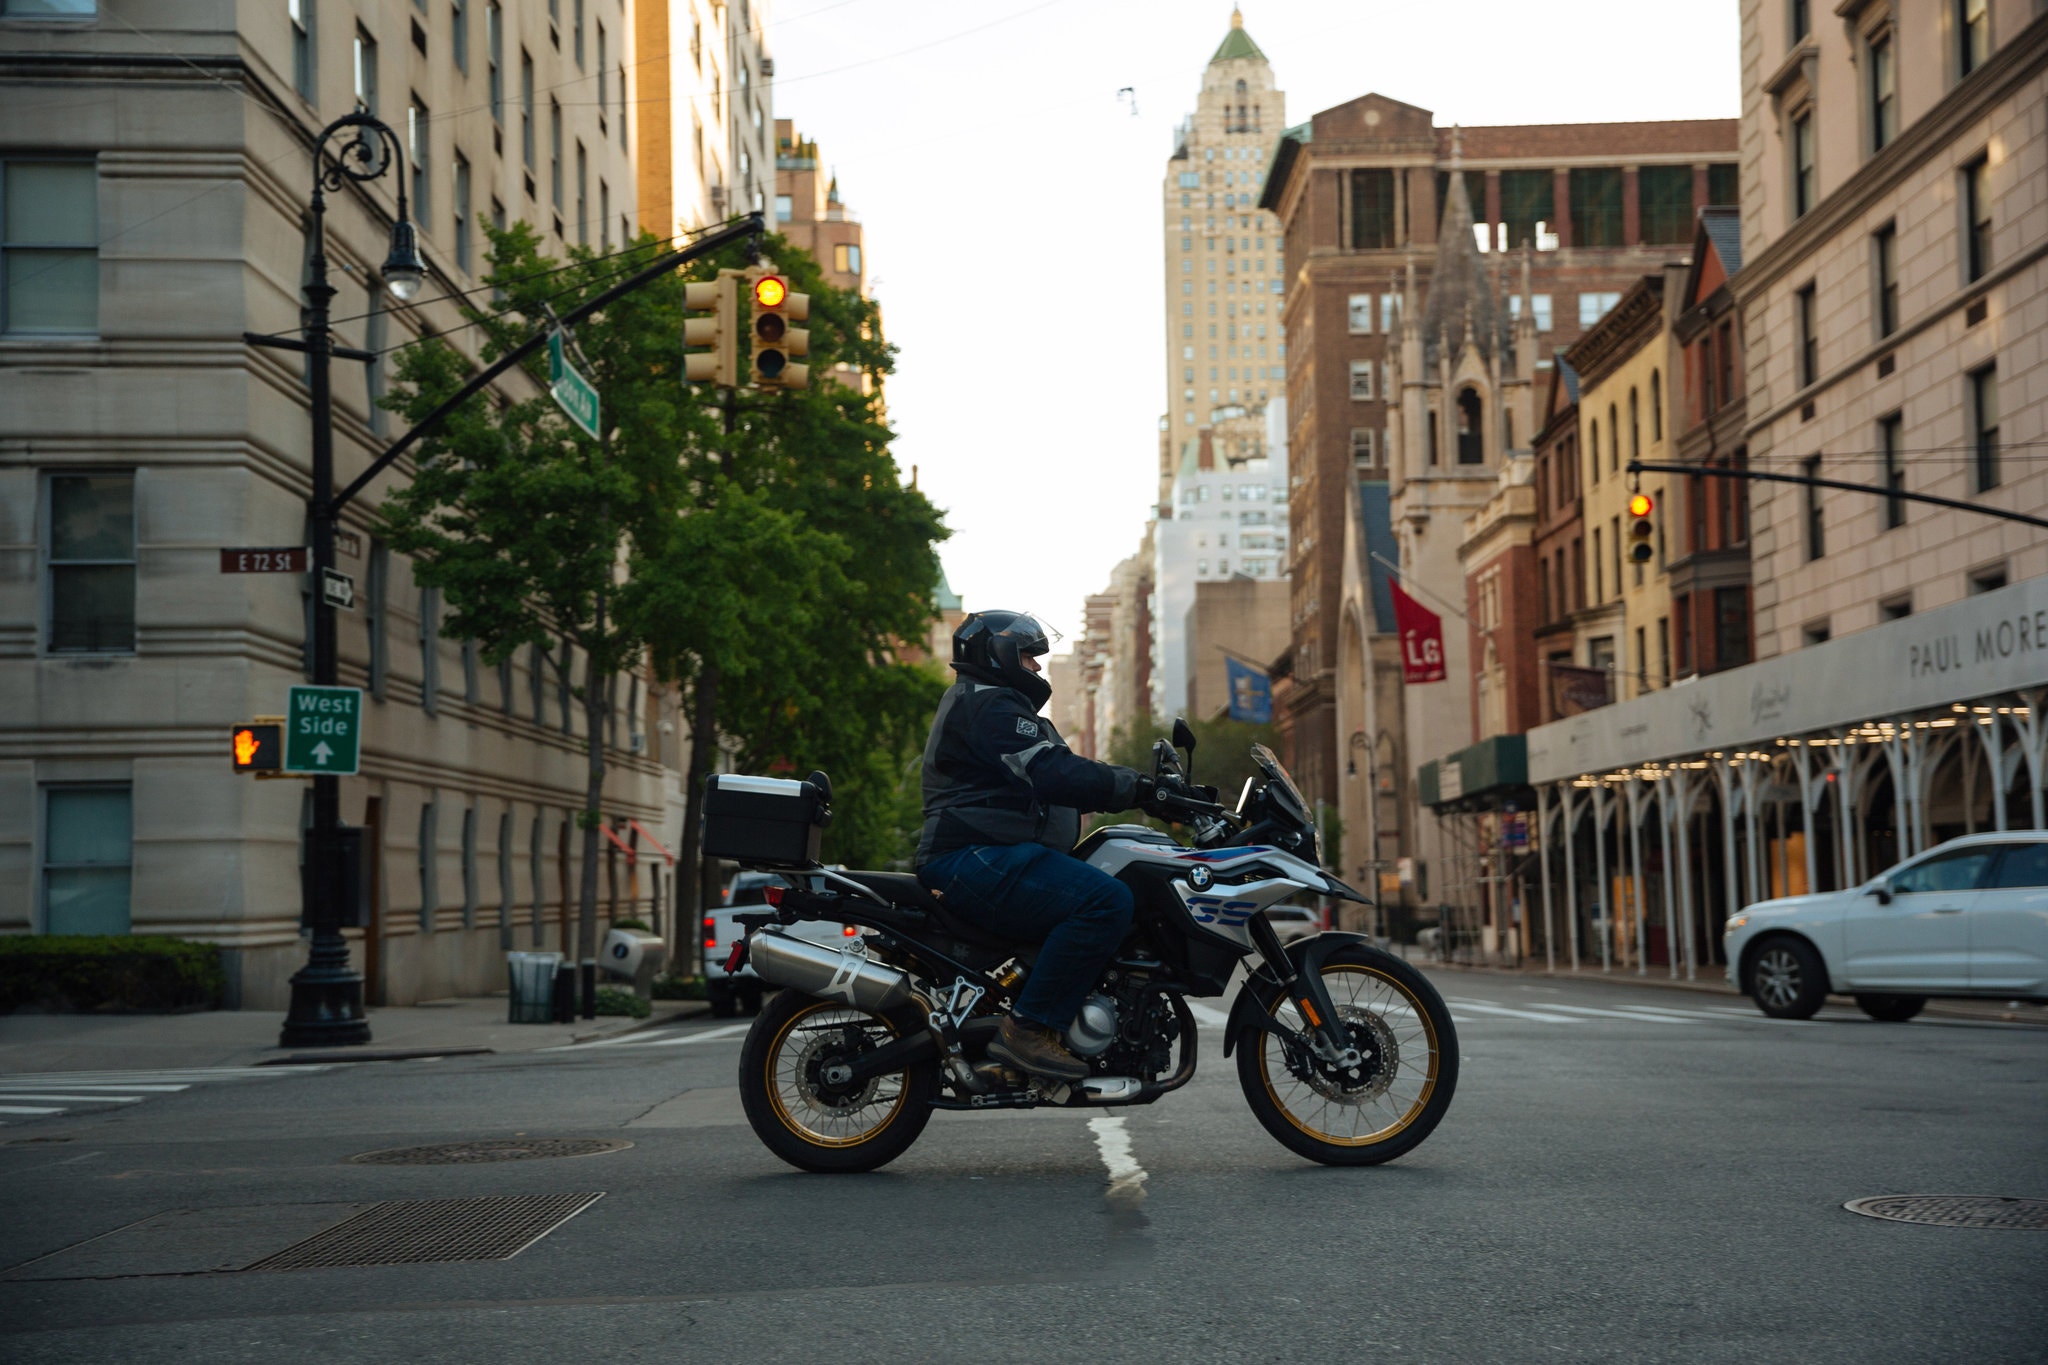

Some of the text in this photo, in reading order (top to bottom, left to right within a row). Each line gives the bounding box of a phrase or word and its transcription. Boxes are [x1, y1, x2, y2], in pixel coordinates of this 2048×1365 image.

[239, 552, 291, 571] E 72 St
[1909, 610, 2048, 678] PAUL MORE
[297, 694, 353, 713] West
[300, 716, 348, 736] Side
[1186, 897, 1257, 926] GS
